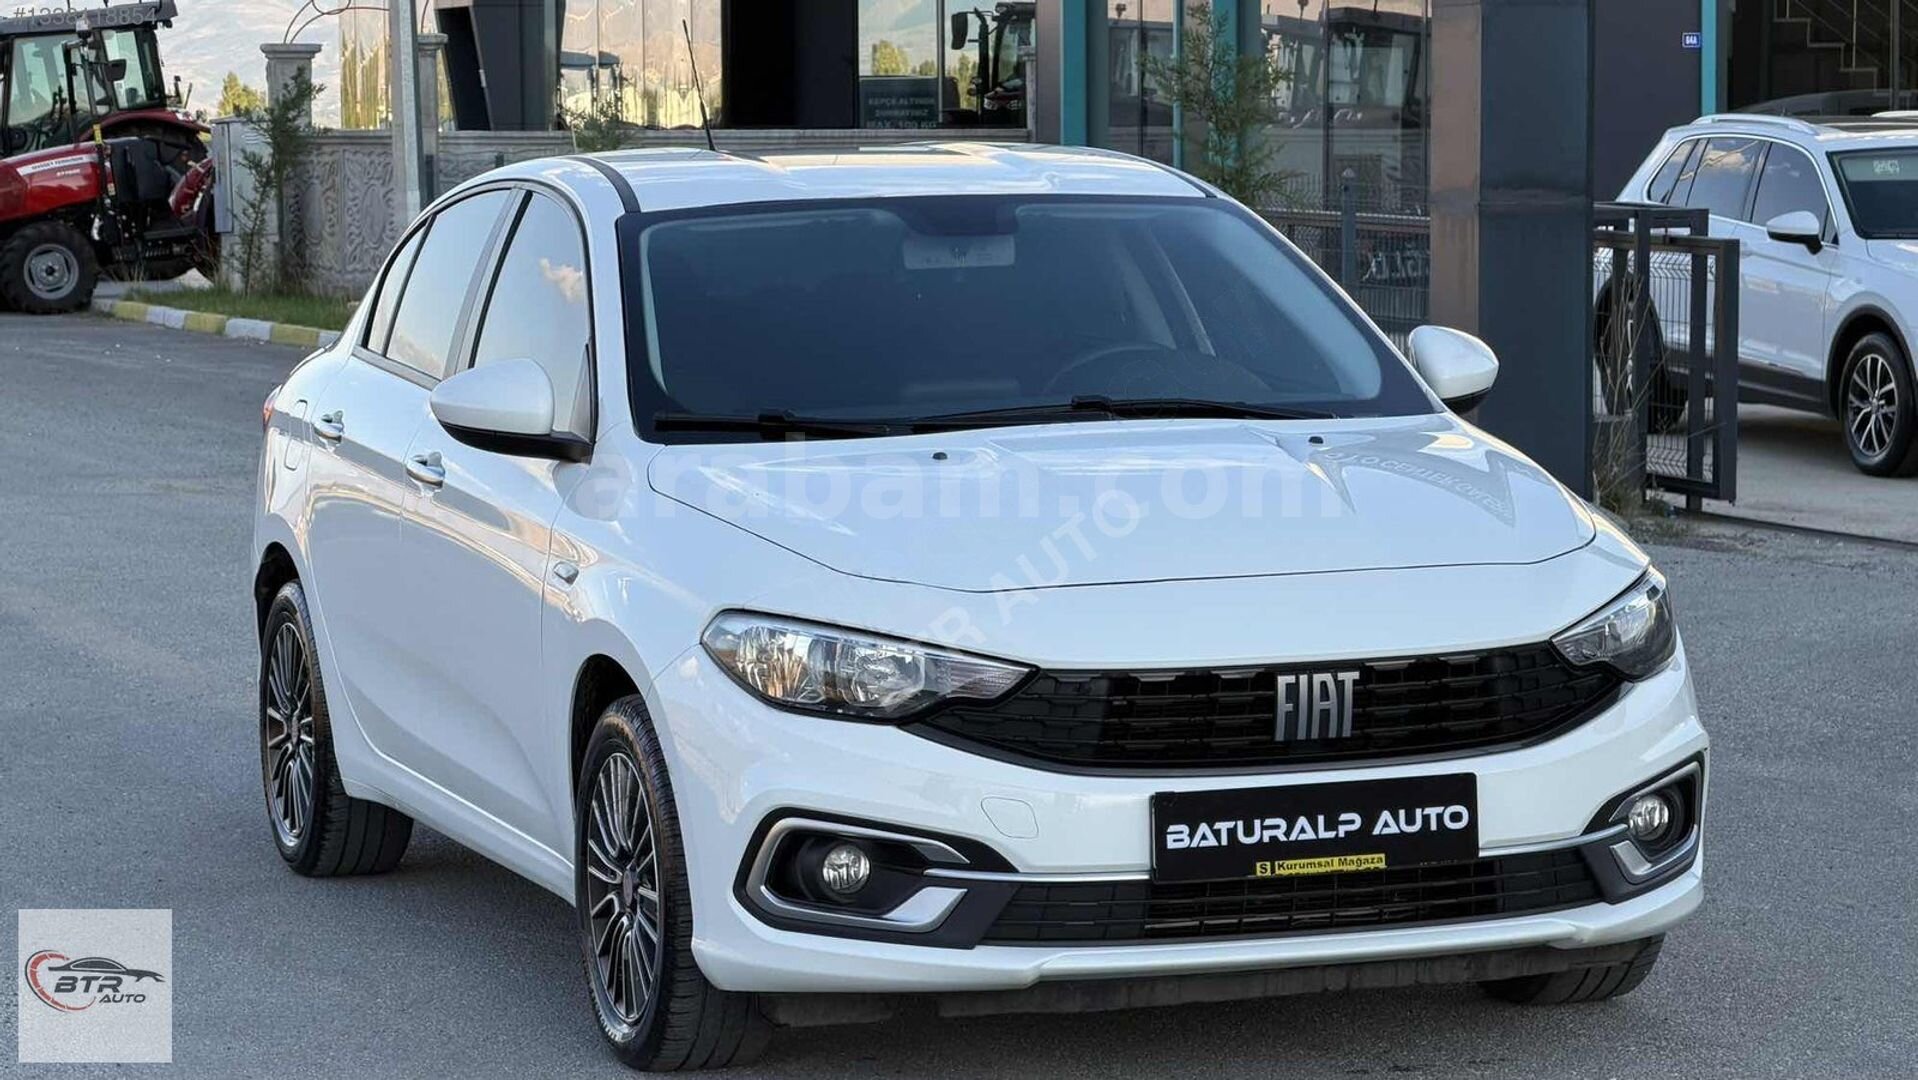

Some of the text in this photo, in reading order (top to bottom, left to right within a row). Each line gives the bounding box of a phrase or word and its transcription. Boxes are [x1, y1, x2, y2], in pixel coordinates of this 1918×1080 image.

[1274, 671, 1360, 742] FIAT
[1166, 805, 1469, 849] BATURALP AUTO
[1277, 858, 1335, 872] Kurumsal
[1337, 856, 1384, 869] Mağaza
